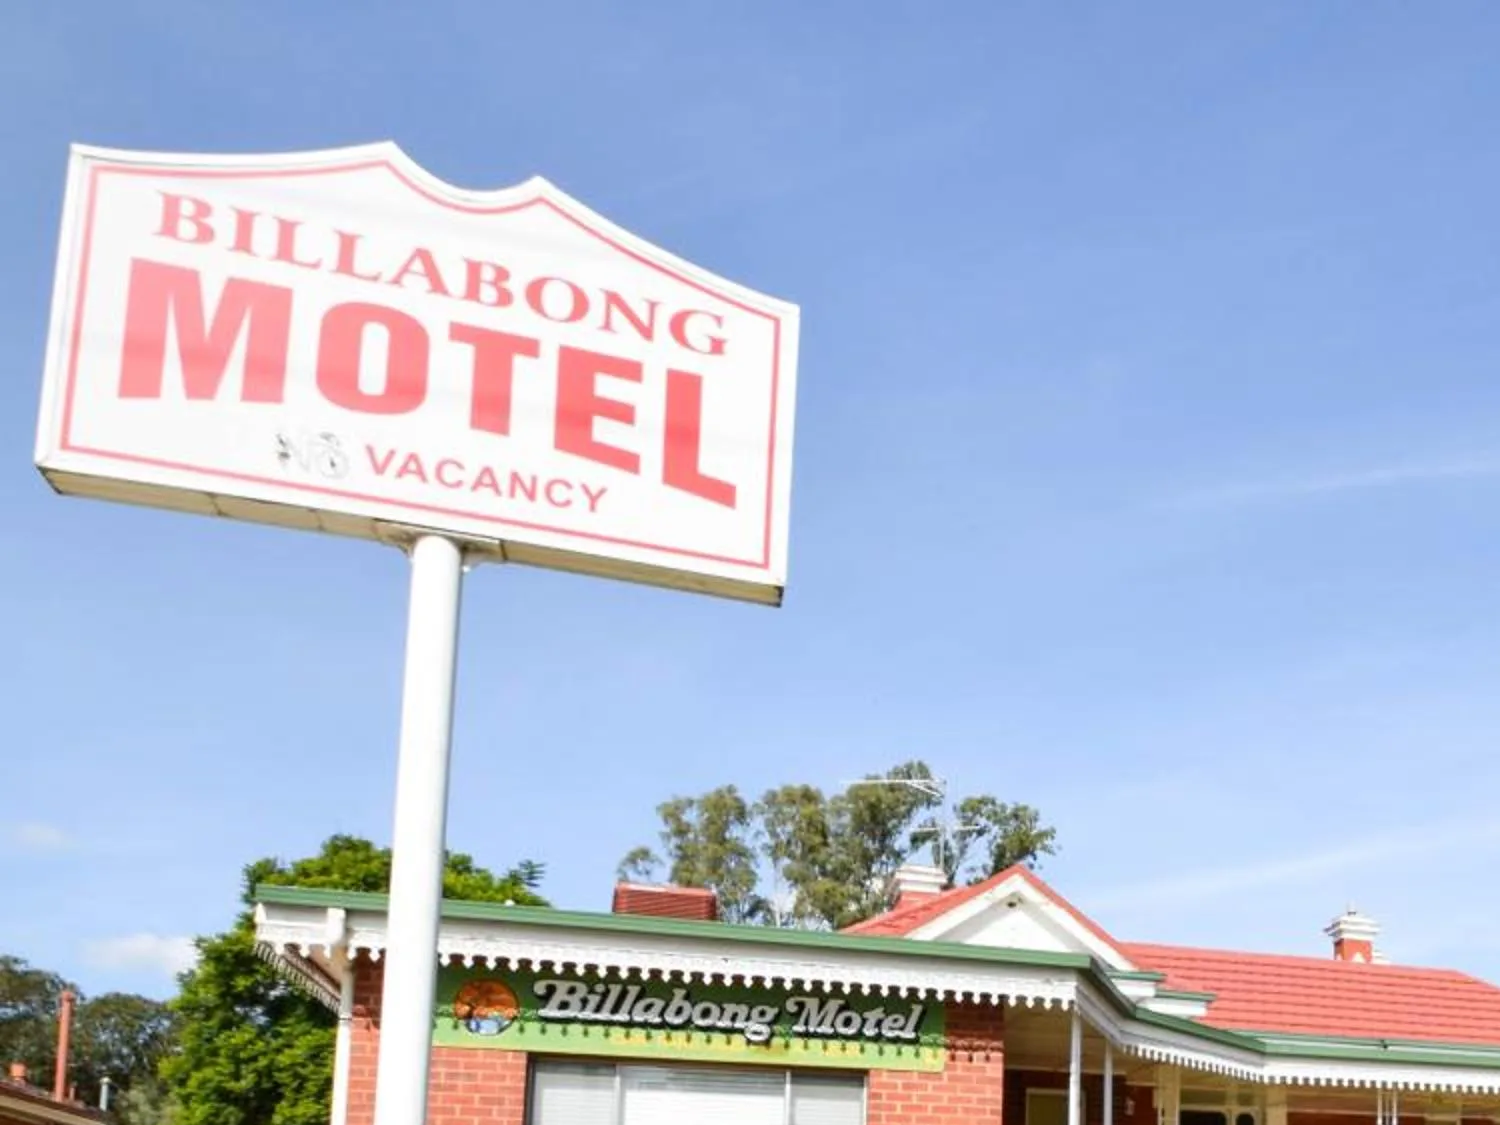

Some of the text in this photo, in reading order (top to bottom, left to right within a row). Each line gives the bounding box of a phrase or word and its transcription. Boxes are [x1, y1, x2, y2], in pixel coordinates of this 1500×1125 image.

[154, 191, 728, 356] BILLABONG
[118, 257, 737, 509] MOTEL
[365, 444, 608, 512] VACANCY
[533, 979, 924, 1041] Billabong Motel
